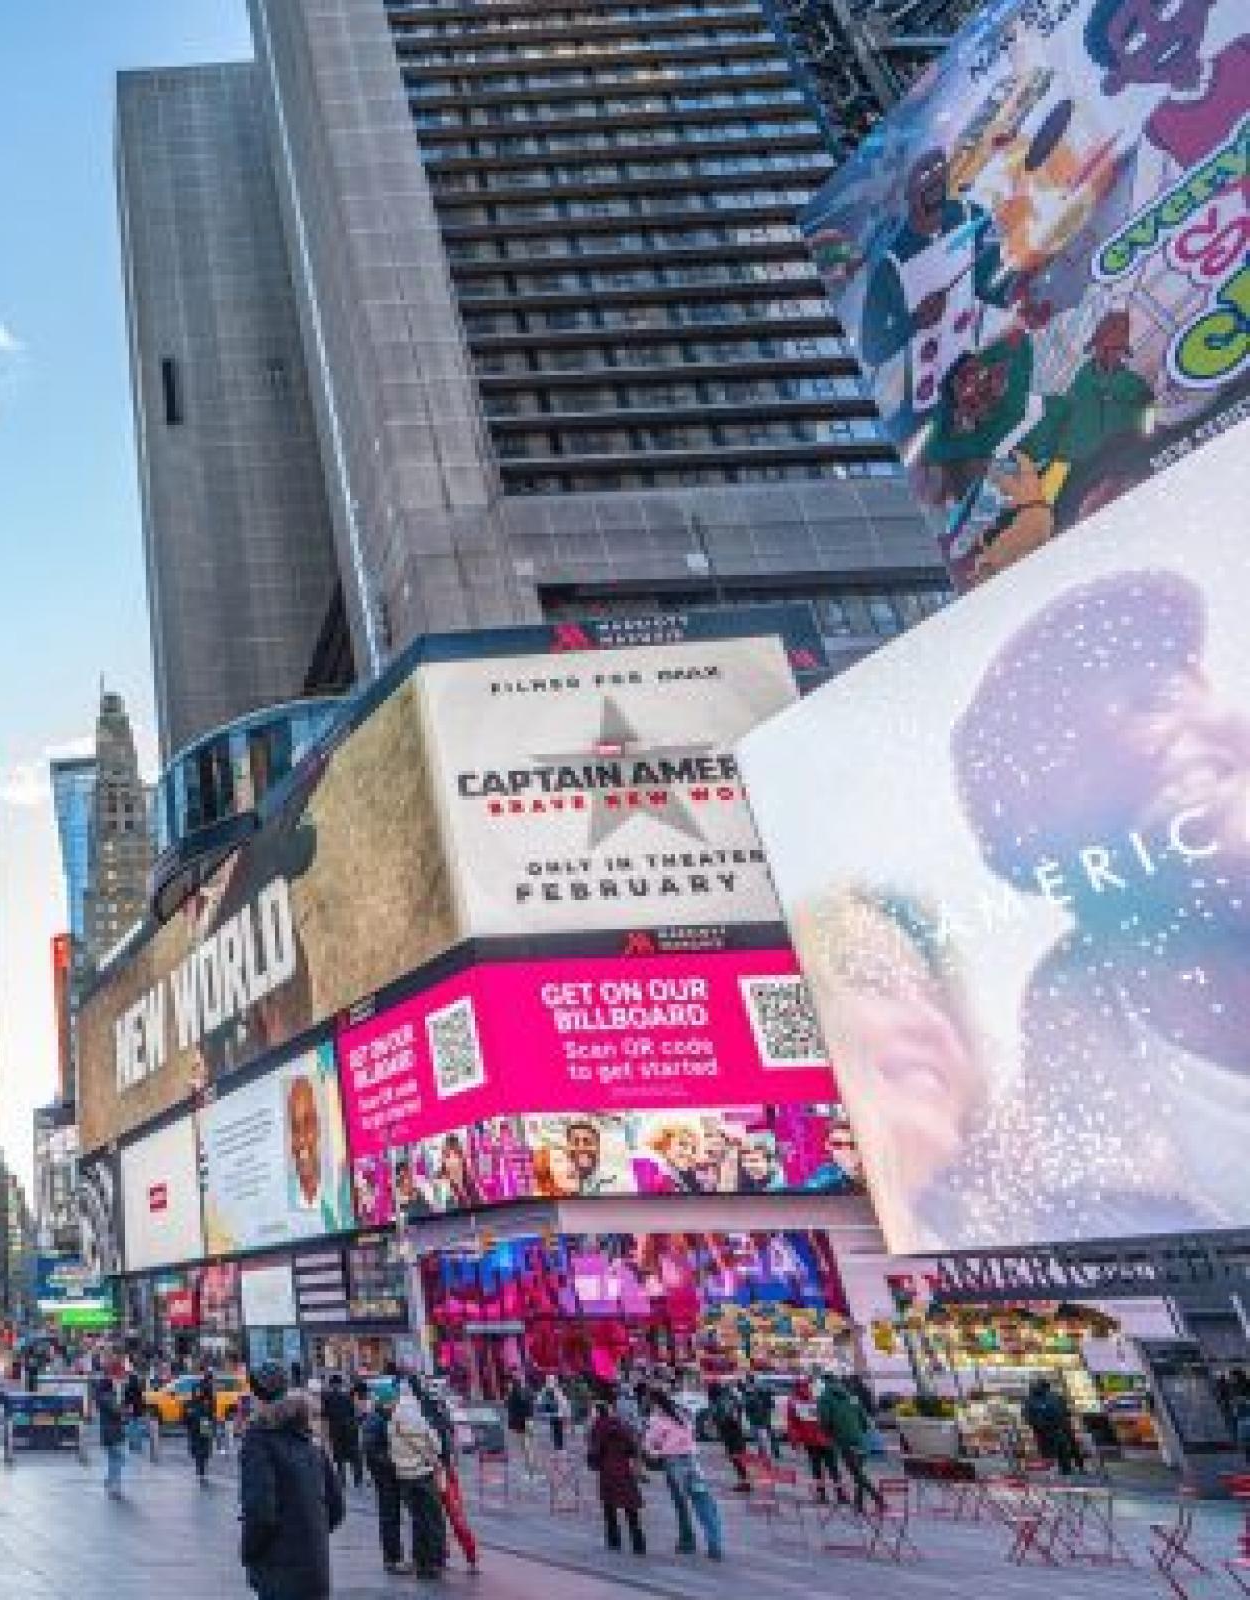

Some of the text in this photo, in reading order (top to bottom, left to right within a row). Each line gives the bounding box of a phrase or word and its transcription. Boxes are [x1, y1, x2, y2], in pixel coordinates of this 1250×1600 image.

[489, 678, 580, 694] FILMED
[594, 671, 643, 688] FOR
[457, 763, 623, 797] CAPTAIN
[488, 786, 747, 814] BRAVE NEW WO
[527, 859, 593, 877] ONLY
[605, 857, 634, 872] IN
[515, 874, 737, 903] FEBRUARY
[114, 874, 299, 1094] NEW WORLD
[539, 976, 709, 1007] GET ON OUR
[551, 1003, 709, 1033] BILLBOARD
[562, 1036, 714, 1060] Scan QR code
[566, 1058, 718, 1083] to get started
